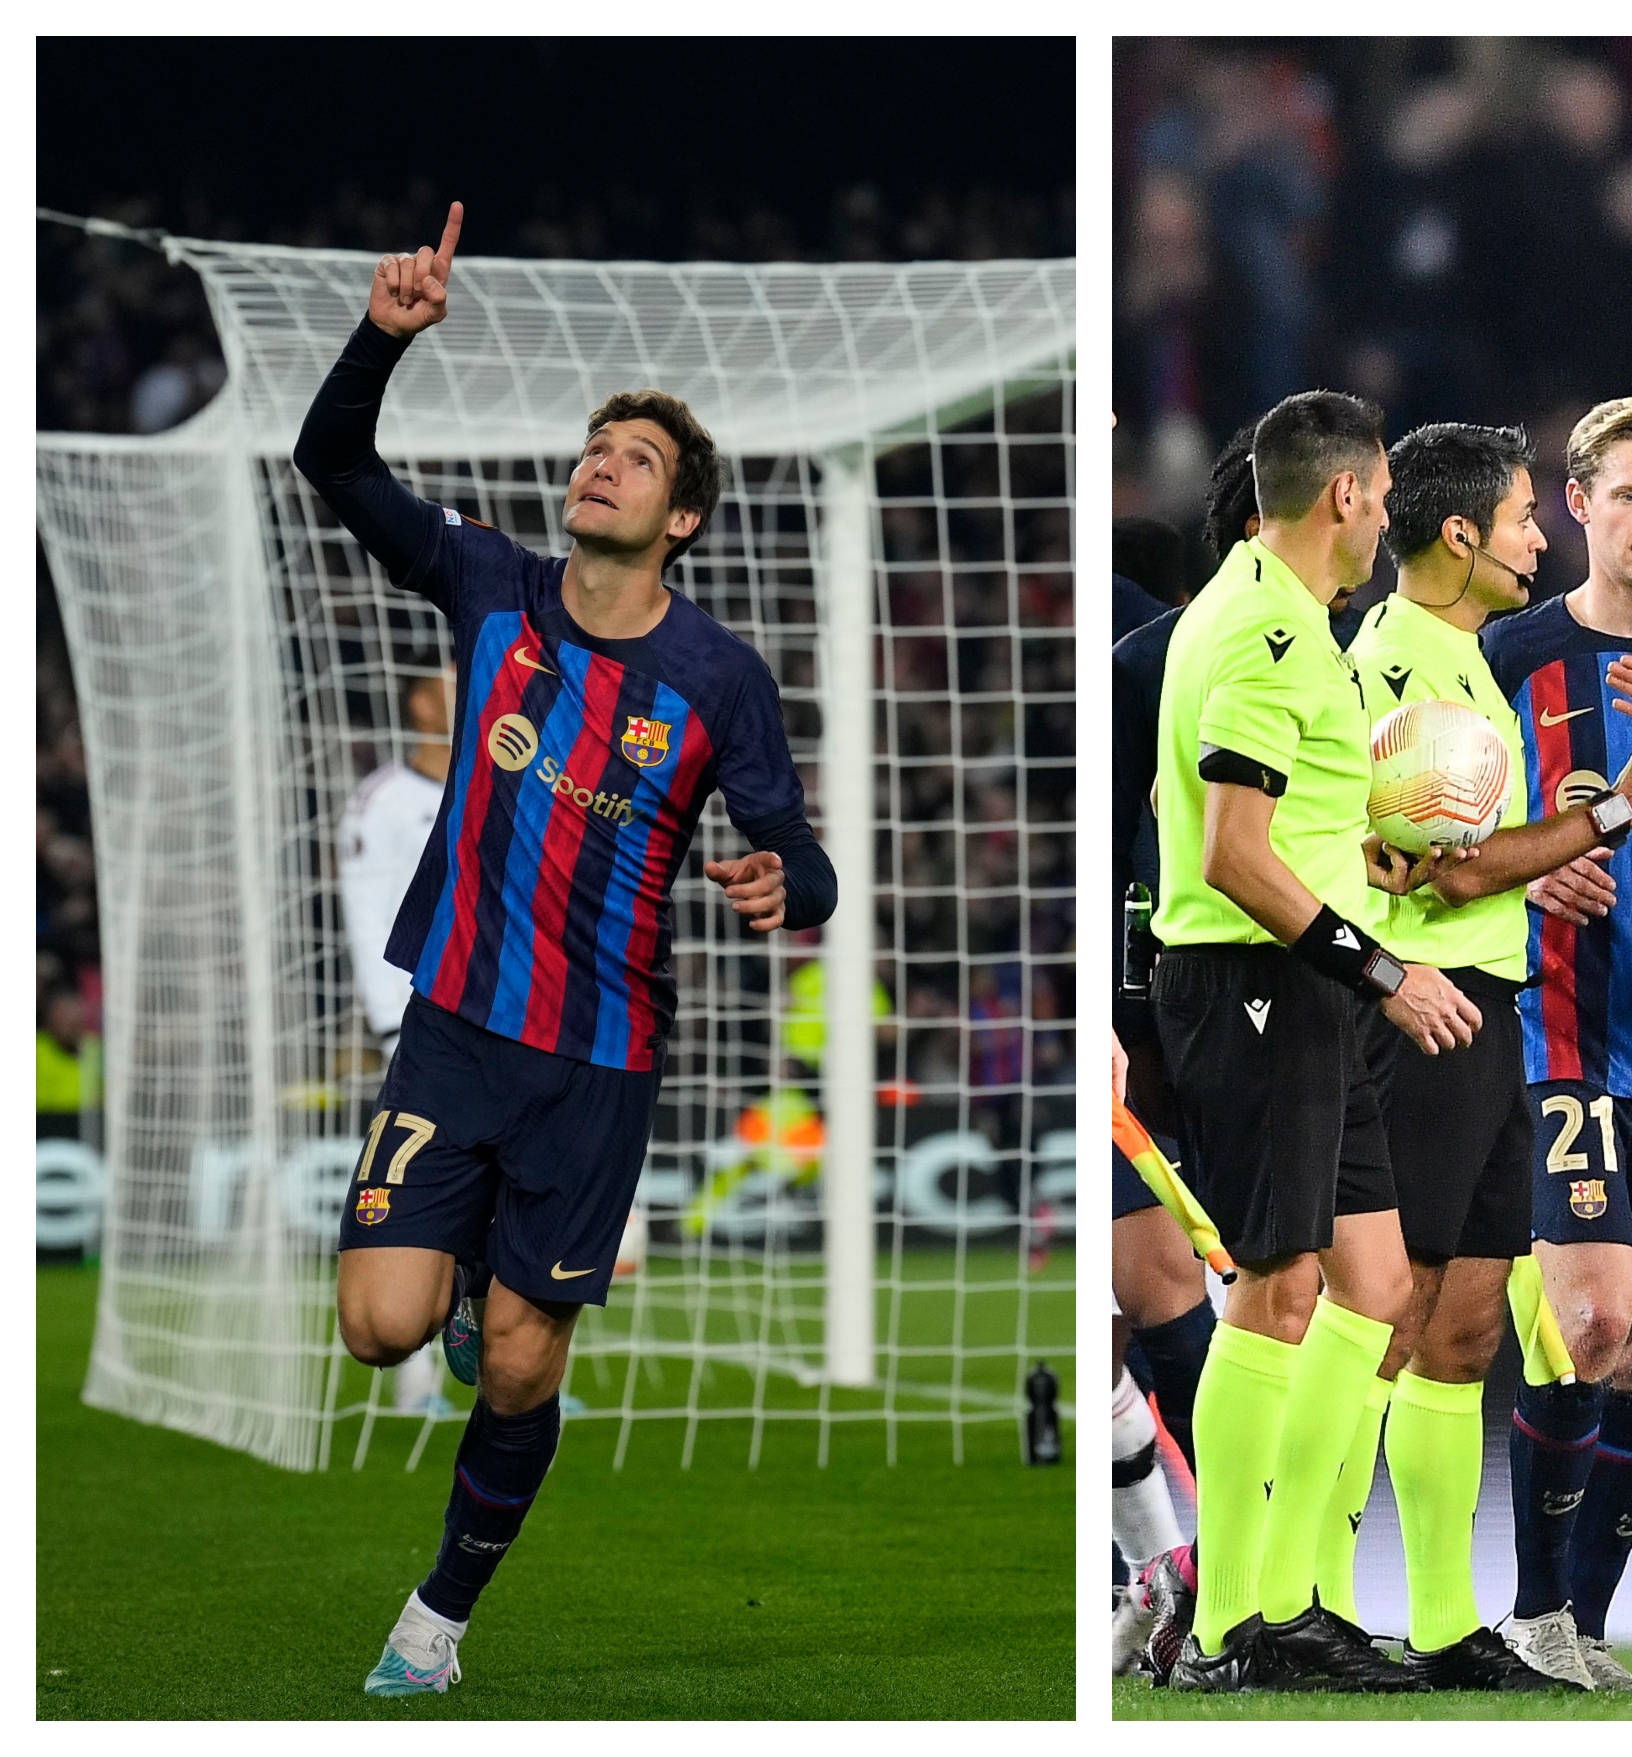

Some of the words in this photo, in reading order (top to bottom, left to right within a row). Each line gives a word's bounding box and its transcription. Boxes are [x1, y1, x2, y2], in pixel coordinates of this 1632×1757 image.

[635, 737, 655, 747] FCB
[536, 756, 646, 827] Spotify
[356, 1110, 437, 1185] 17
[1541, 1094, 1618, 1174] 21
